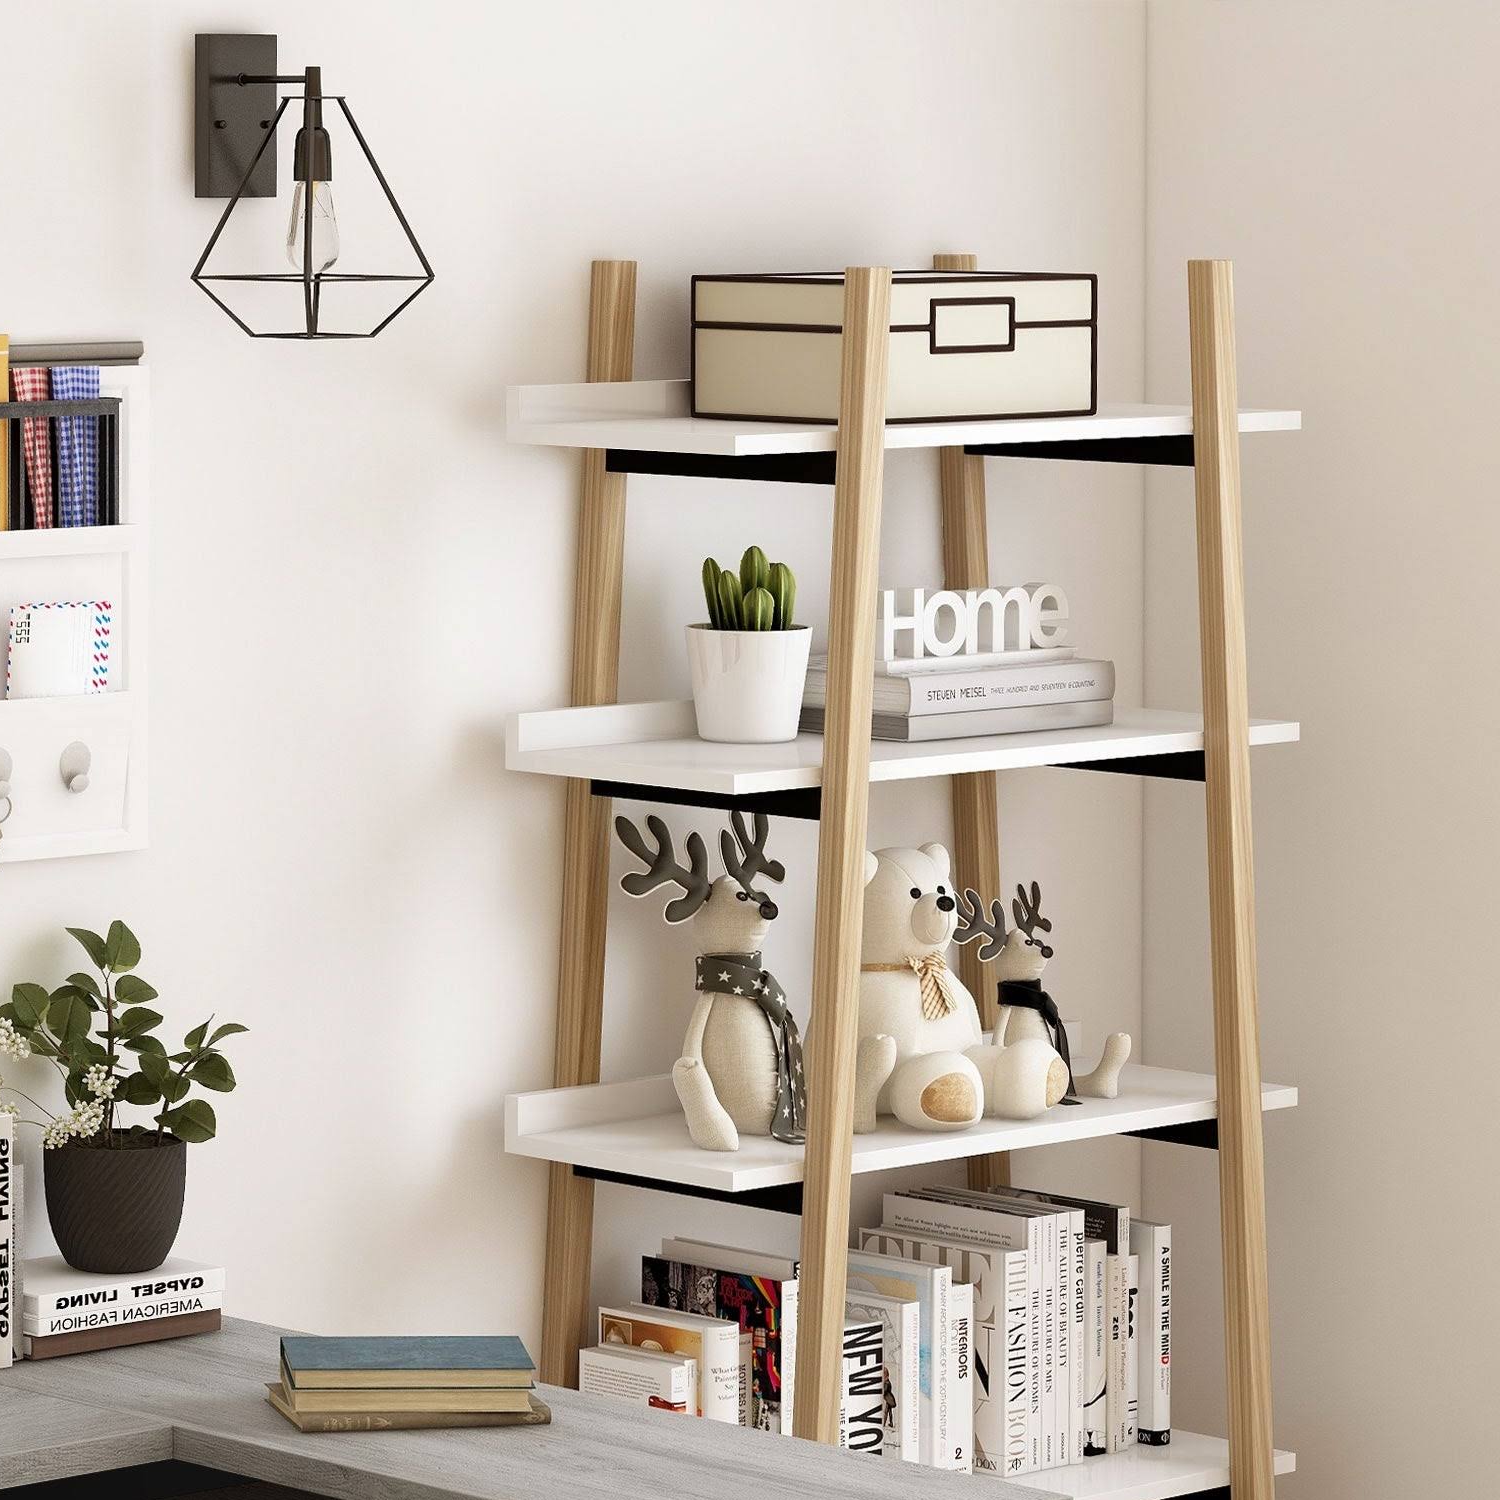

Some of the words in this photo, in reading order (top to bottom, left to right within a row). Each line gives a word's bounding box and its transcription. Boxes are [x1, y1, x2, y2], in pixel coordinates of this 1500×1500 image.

[883, 582, 1069, 661] Home
[927, 689, 956, 701] STEVEN
[960, 686, 987, 699] MEISEL
[1059, 1226, 1068, 1252] THE
[1073, 1232, 1084, 1274] pierre
[1161, 1246, 1170, 1255] A
[1007, 1253, 1027, 1303] THE
[1059, 1254, 1068, 1300] ALLURE
[1161, 1257, 1170, 1292] SMILE
[1031, 1288, 1039, 1311] THE
[1059, 1302, 1068, 1318] OF
[1161, 1295, 1170, 1307] IN
[1031, 1312, 1039, 1354] ALLURE
[1161, 1310, 1170, 1331] THE
[843, 1325, 883, 1397] NEW
[958, 1318, 968, 1380] INTERIORS
[1007, 1306, 1027, 1402] FASHION
[1045, 1353, 1052, 1368] OF
[1059, 1320, 1068, 1368] BEAUTY
[1161, 1334, 1170, 1365] MIND
[939, 1370, 947, 1384] THE
[1031, 1355, 1039, 1371] OF
[1031, 1372, 1039, 1414] WOMEN
[847, 1405, 883, 1457] YO
[939, 1405, 947, 1440] CENTURY
[955, 1448, 963, 1460] 2
